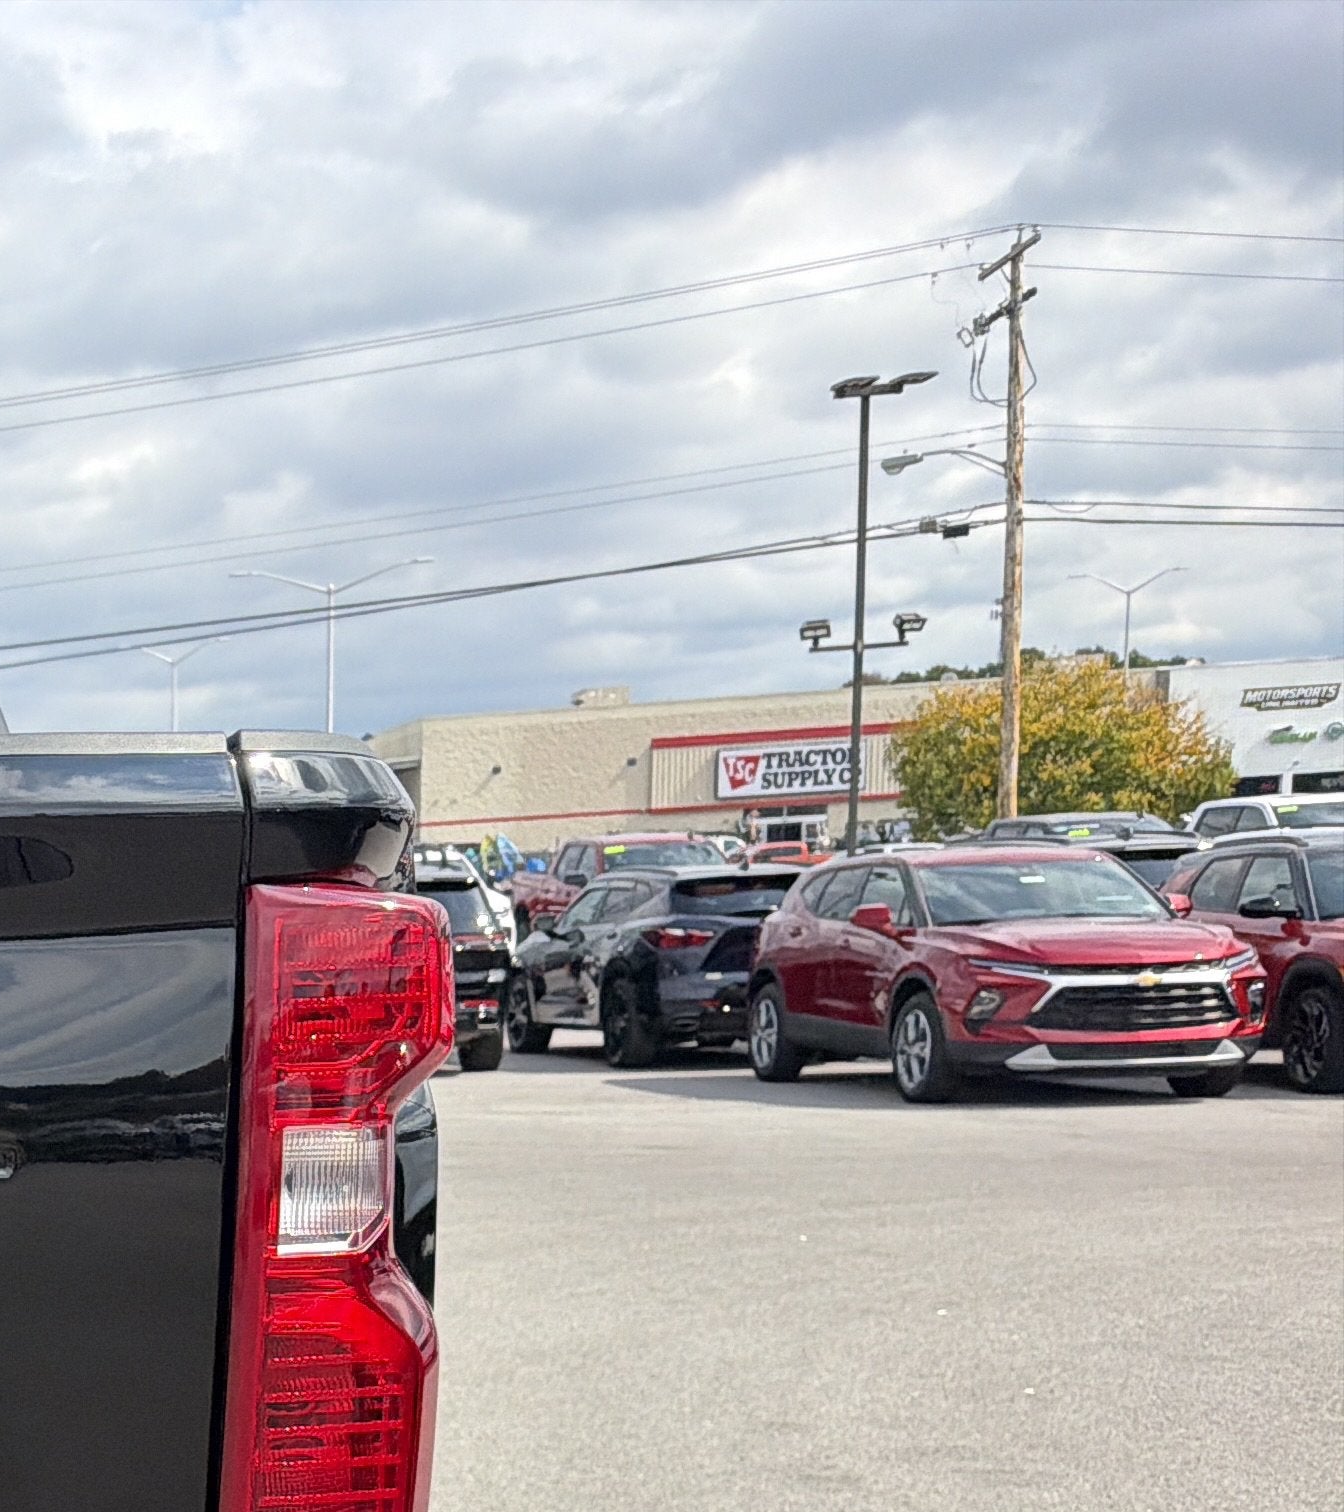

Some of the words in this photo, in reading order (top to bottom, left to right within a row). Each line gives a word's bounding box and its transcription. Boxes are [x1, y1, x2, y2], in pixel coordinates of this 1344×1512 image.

[1243, 685, 1338, 704] MOTORSPORTS
[726, 756, 755, 784] TSC
[761, 767, 836, 790] SUPPLY
